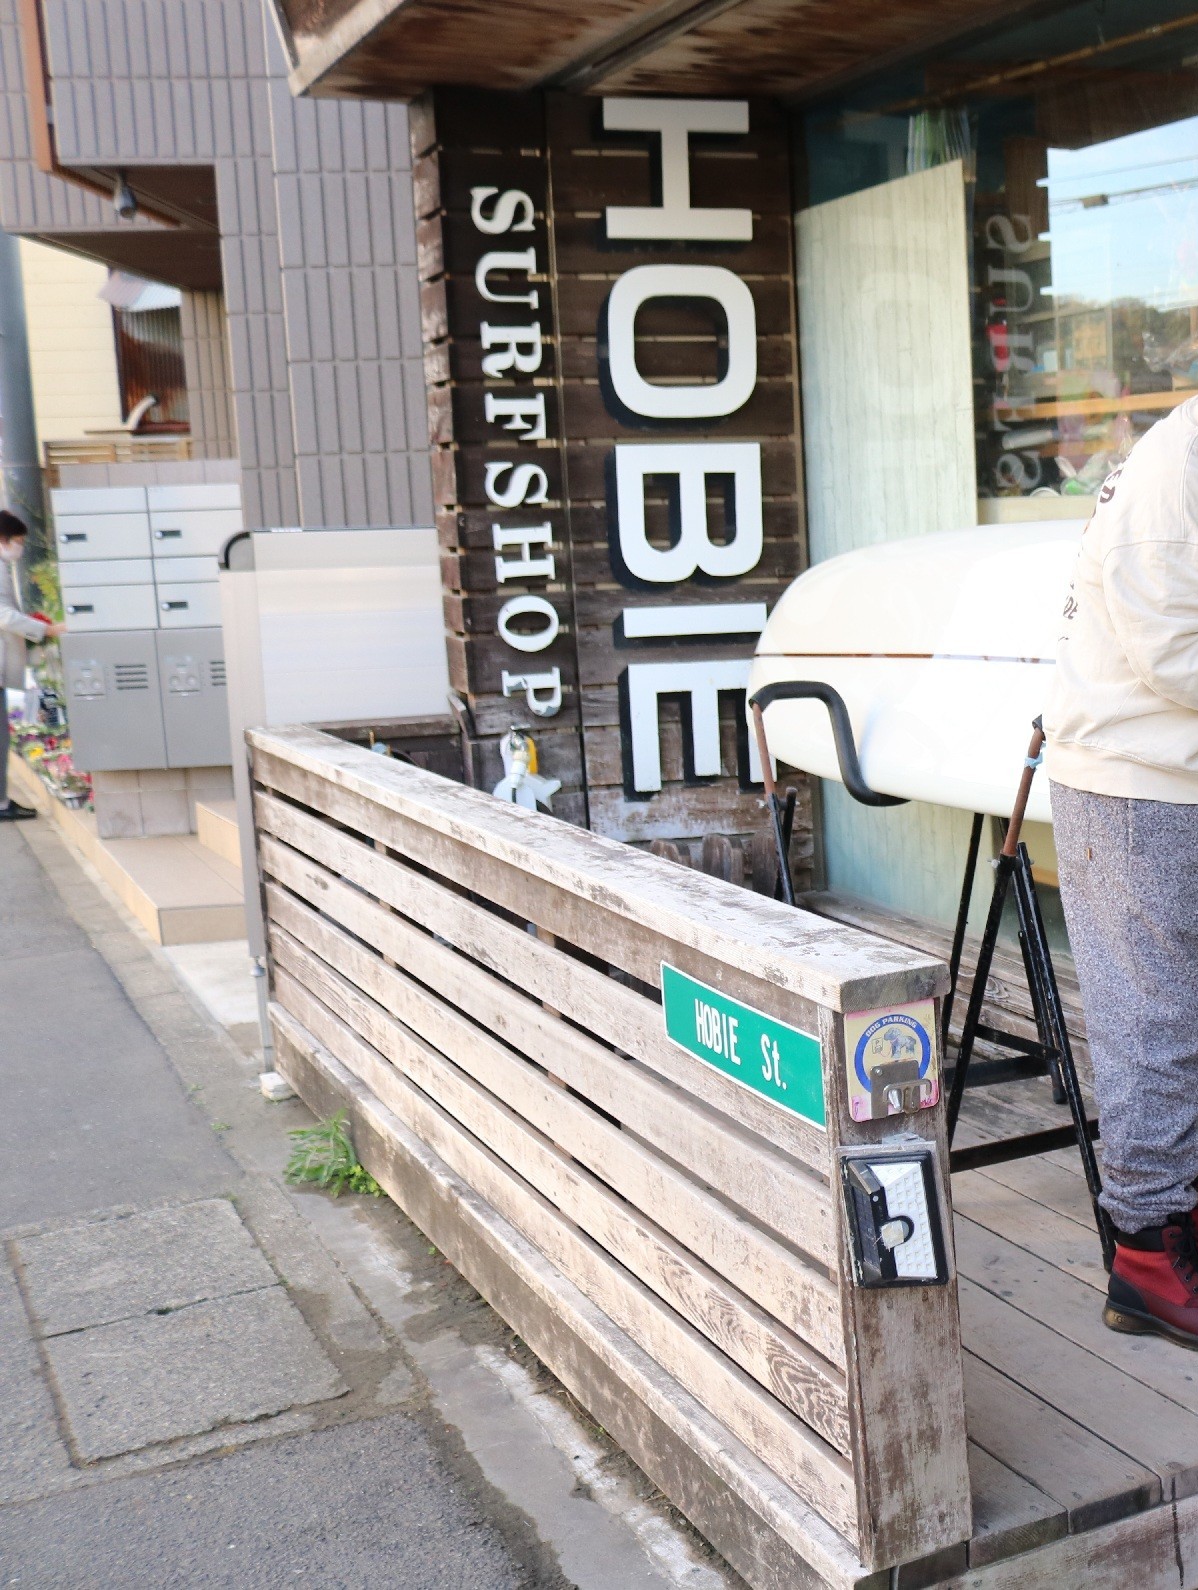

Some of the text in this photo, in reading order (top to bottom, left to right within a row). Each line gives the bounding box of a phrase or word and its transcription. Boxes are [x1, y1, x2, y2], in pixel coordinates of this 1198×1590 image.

[602, 97, 778, 793] HOBIE
[695, 998, 787, 1090] HOBIE St.
[865, 1015, 918, 1038] DOG PARKING
